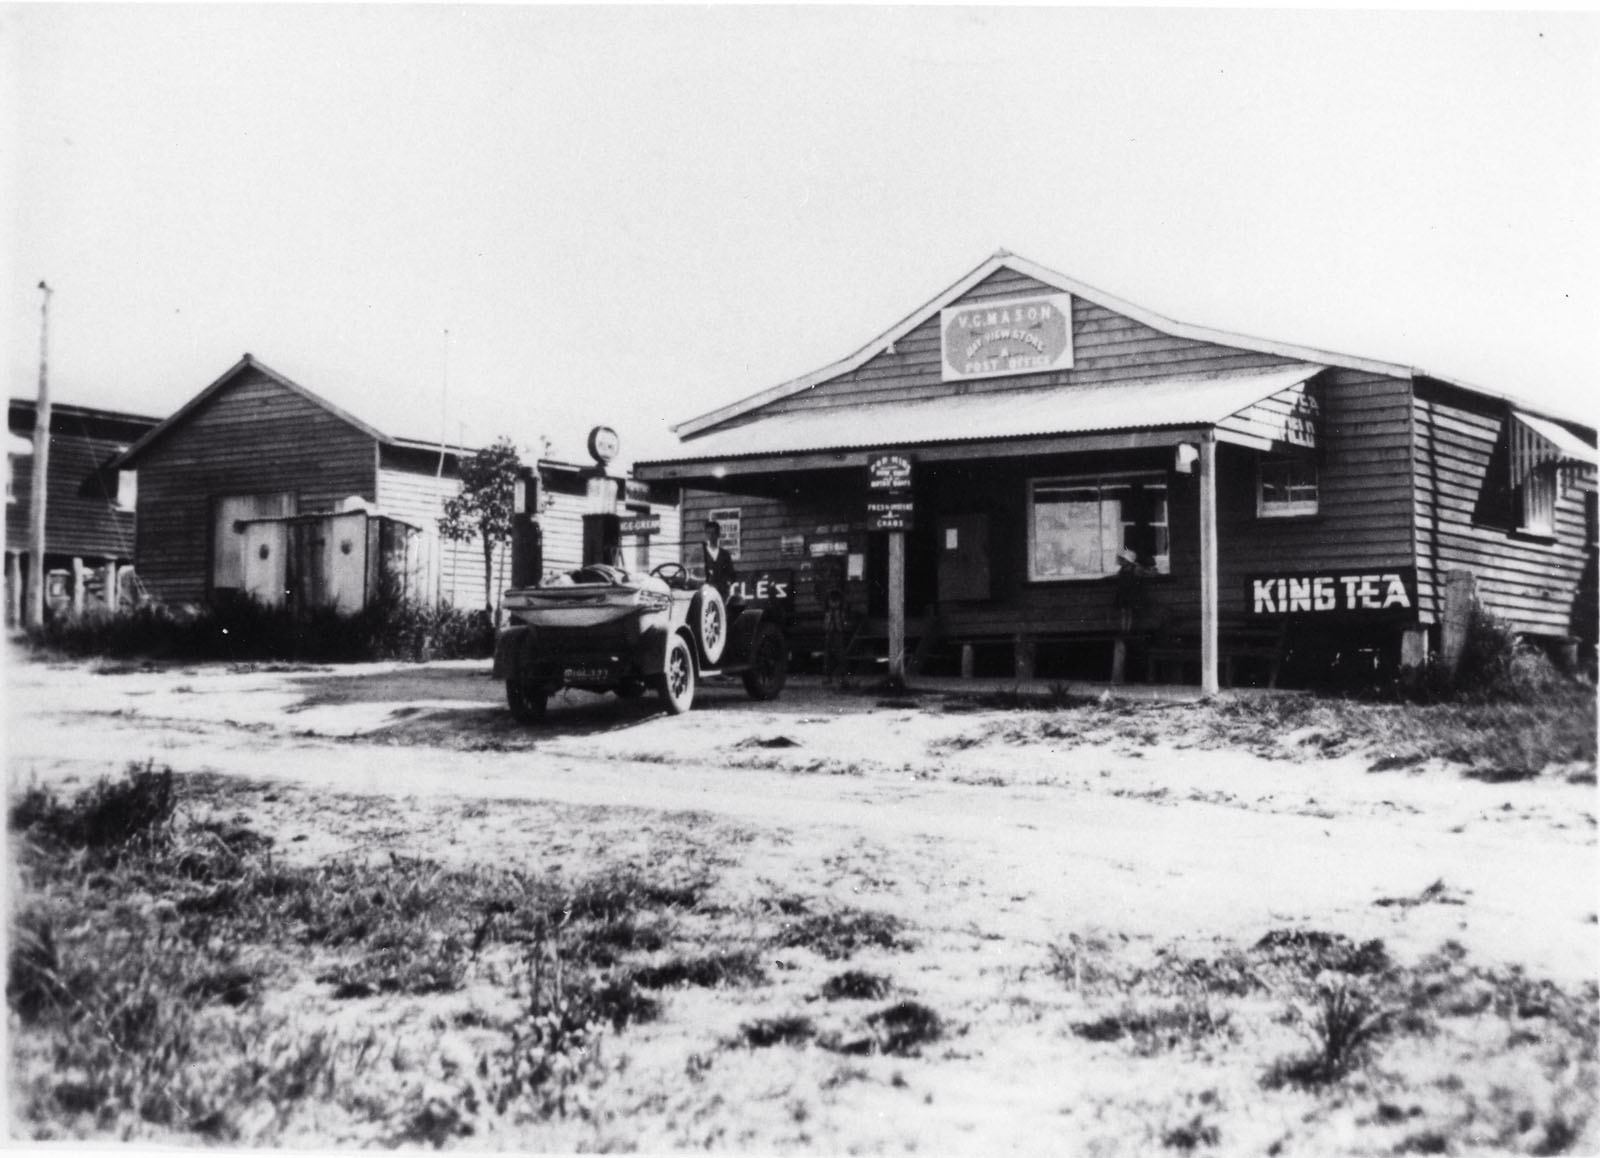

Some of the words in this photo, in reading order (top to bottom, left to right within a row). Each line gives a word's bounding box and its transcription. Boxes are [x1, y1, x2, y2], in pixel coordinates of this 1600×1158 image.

[965, 360, 998, 373] POST
[1253, 577, 1336, 613] KING
[1340, 574, 1411, 610] TEA
